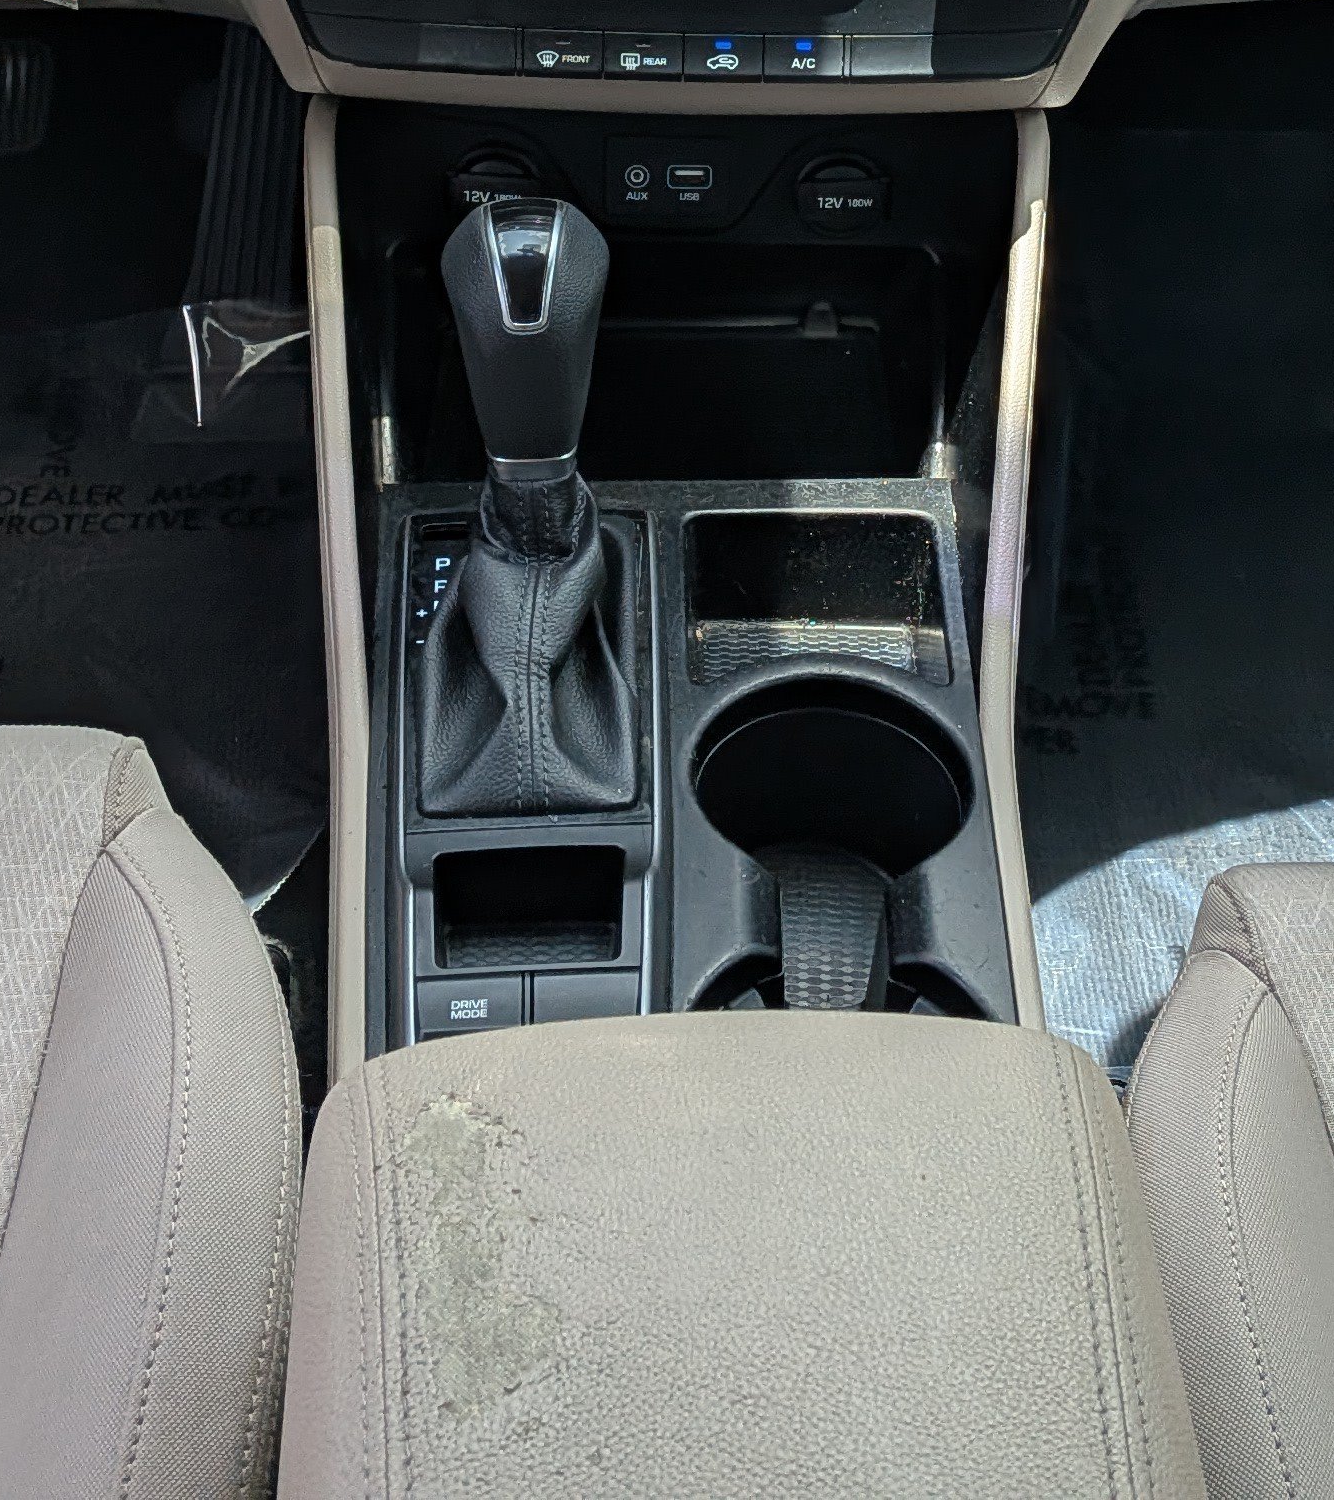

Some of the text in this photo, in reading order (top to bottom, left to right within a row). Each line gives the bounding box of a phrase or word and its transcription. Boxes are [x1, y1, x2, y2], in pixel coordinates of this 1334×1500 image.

[561, 54, 591, 65] FRONT
[642, 57, 667, 66] REAR
[791, 58, 816, 70] A/C
[463, 190, 491, 203] 12V
[626, 191, 648, 201] AUX
[679, 192, 700, 201] USB
[818, 197, 843, 209] 12V
[435, 557, 451, 571] P
[451, 999, 488, 1010] DRIVE
[450, 1009, 488, 1020] MODE
